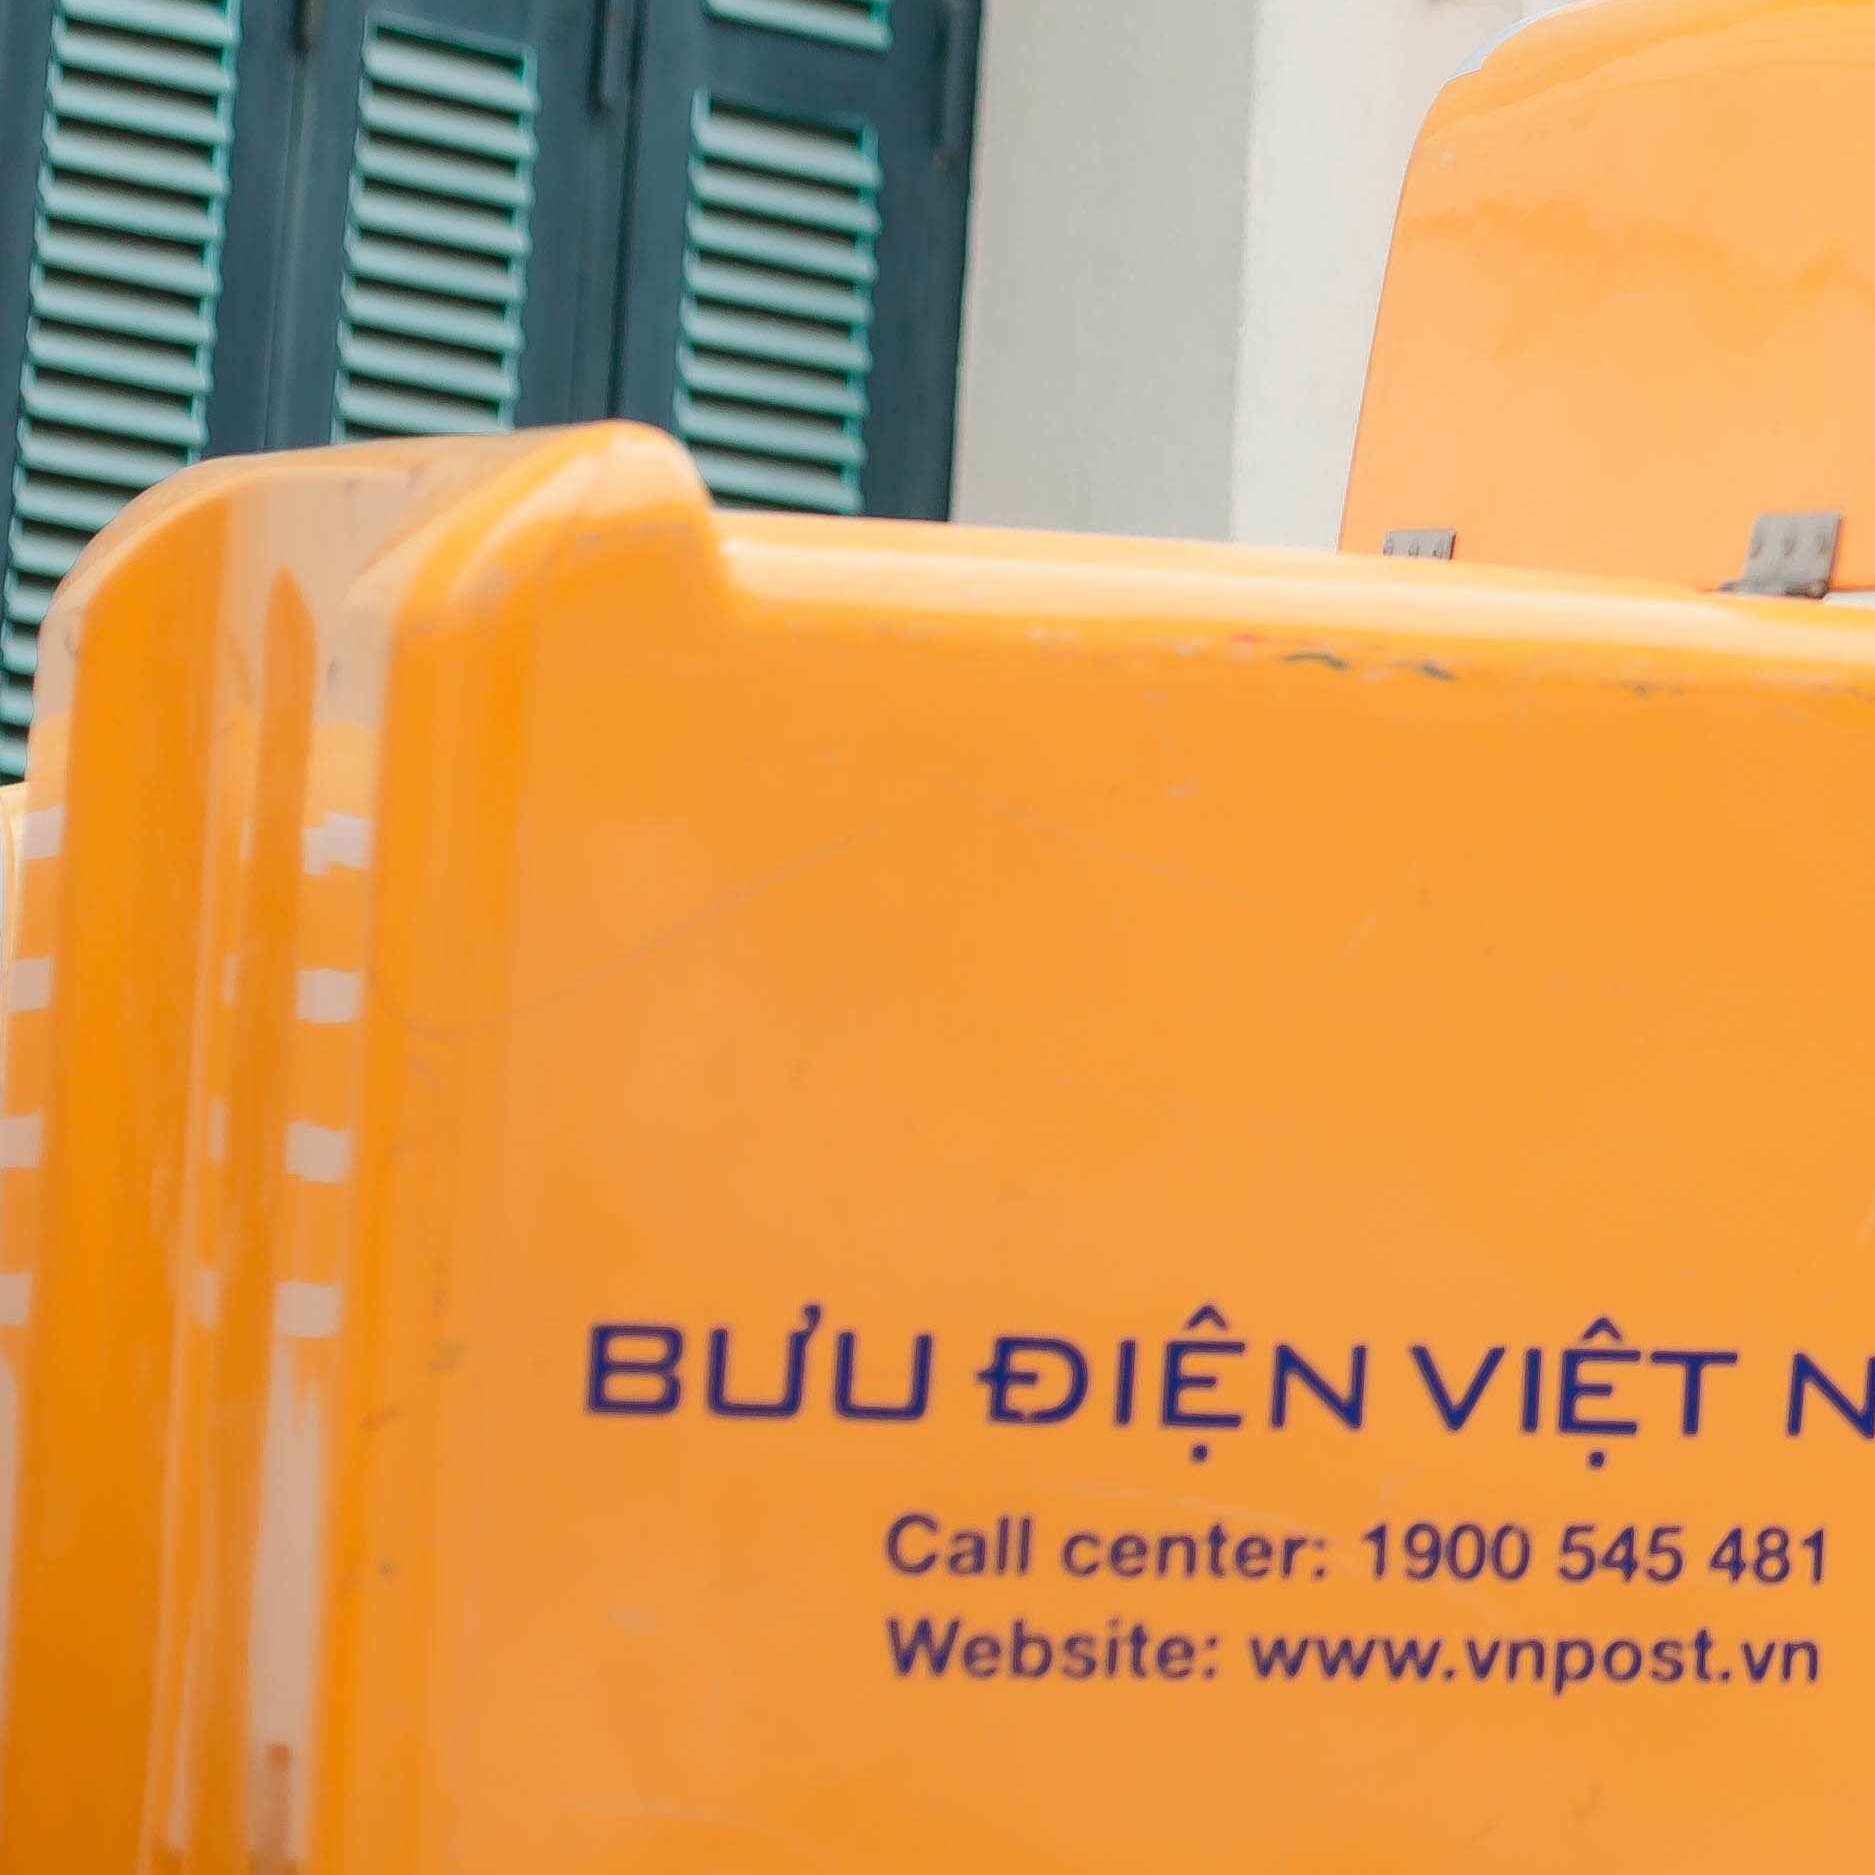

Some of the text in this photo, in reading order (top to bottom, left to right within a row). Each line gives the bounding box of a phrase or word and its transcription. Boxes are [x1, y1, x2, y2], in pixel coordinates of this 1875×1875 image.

[584, 1303, 934, 1423] BƯU
[975, 1303, 1367, 1464] ĐIỆN
[1408, 1316, 1740, 1470] VIỆT
[884, 1513, 1826, 1585] Call center: 1900 545 481
[886, 1617, 1820, 1697] Website: www.vnpost.vn
